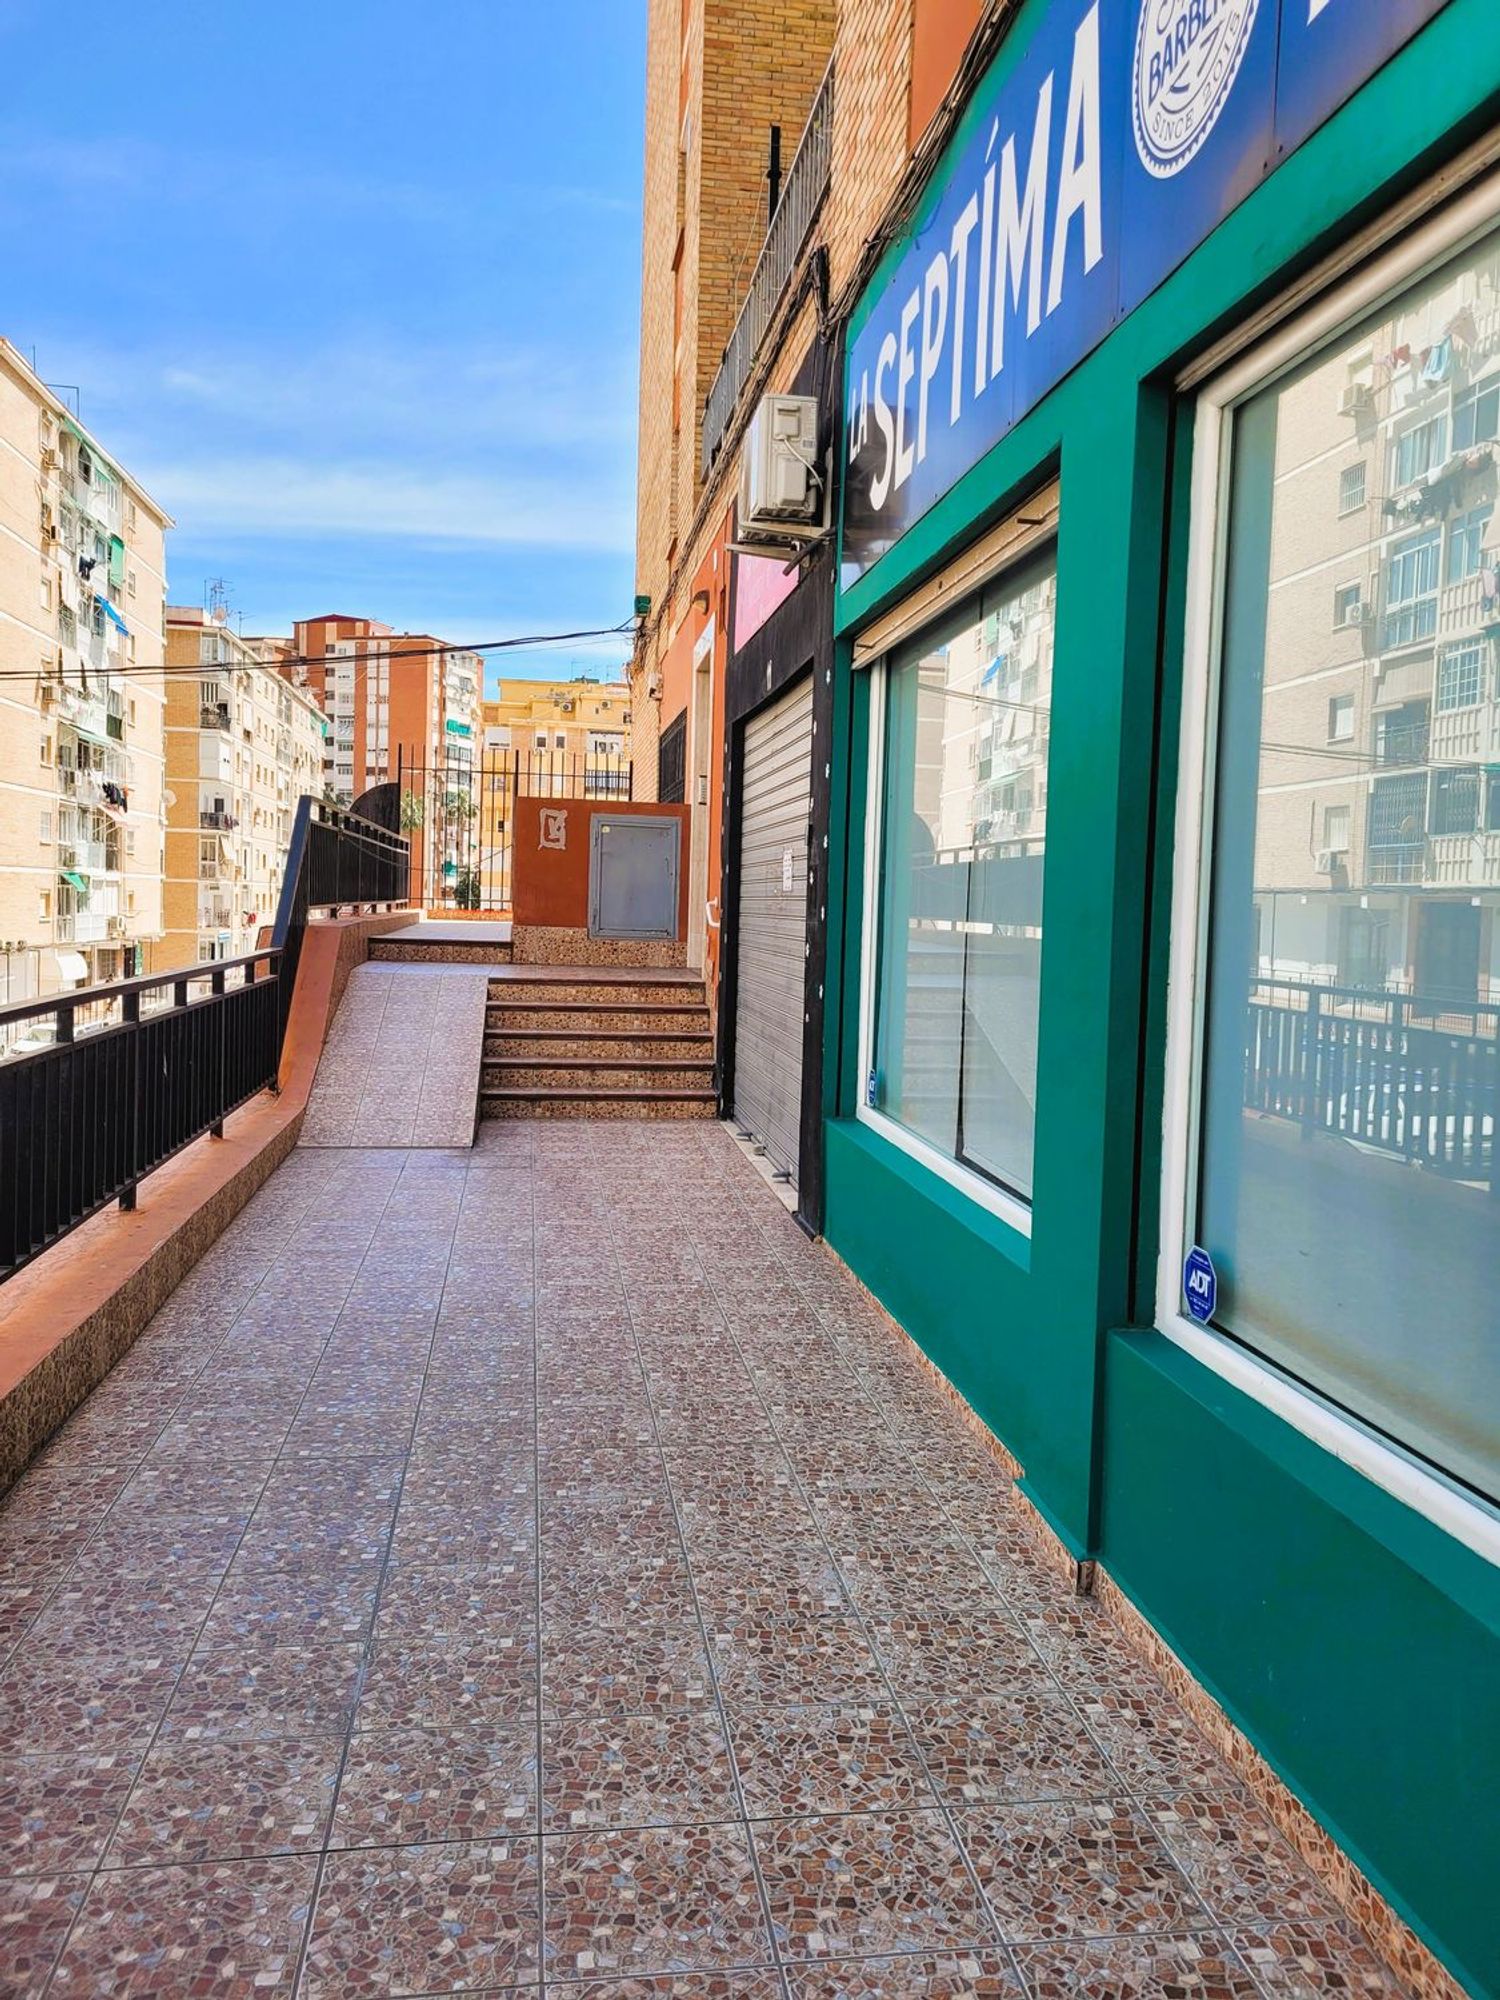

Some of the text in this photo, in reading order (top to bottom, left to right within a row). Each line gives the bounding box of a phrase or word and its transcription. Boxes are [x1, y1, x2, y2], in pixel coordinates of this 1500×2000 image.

[1153, 108, 1194, 141] SINCE
[850, 0, 1103, 511] LA SEPTÍMA
[1189, 1268, 1211, 1298] ADT
